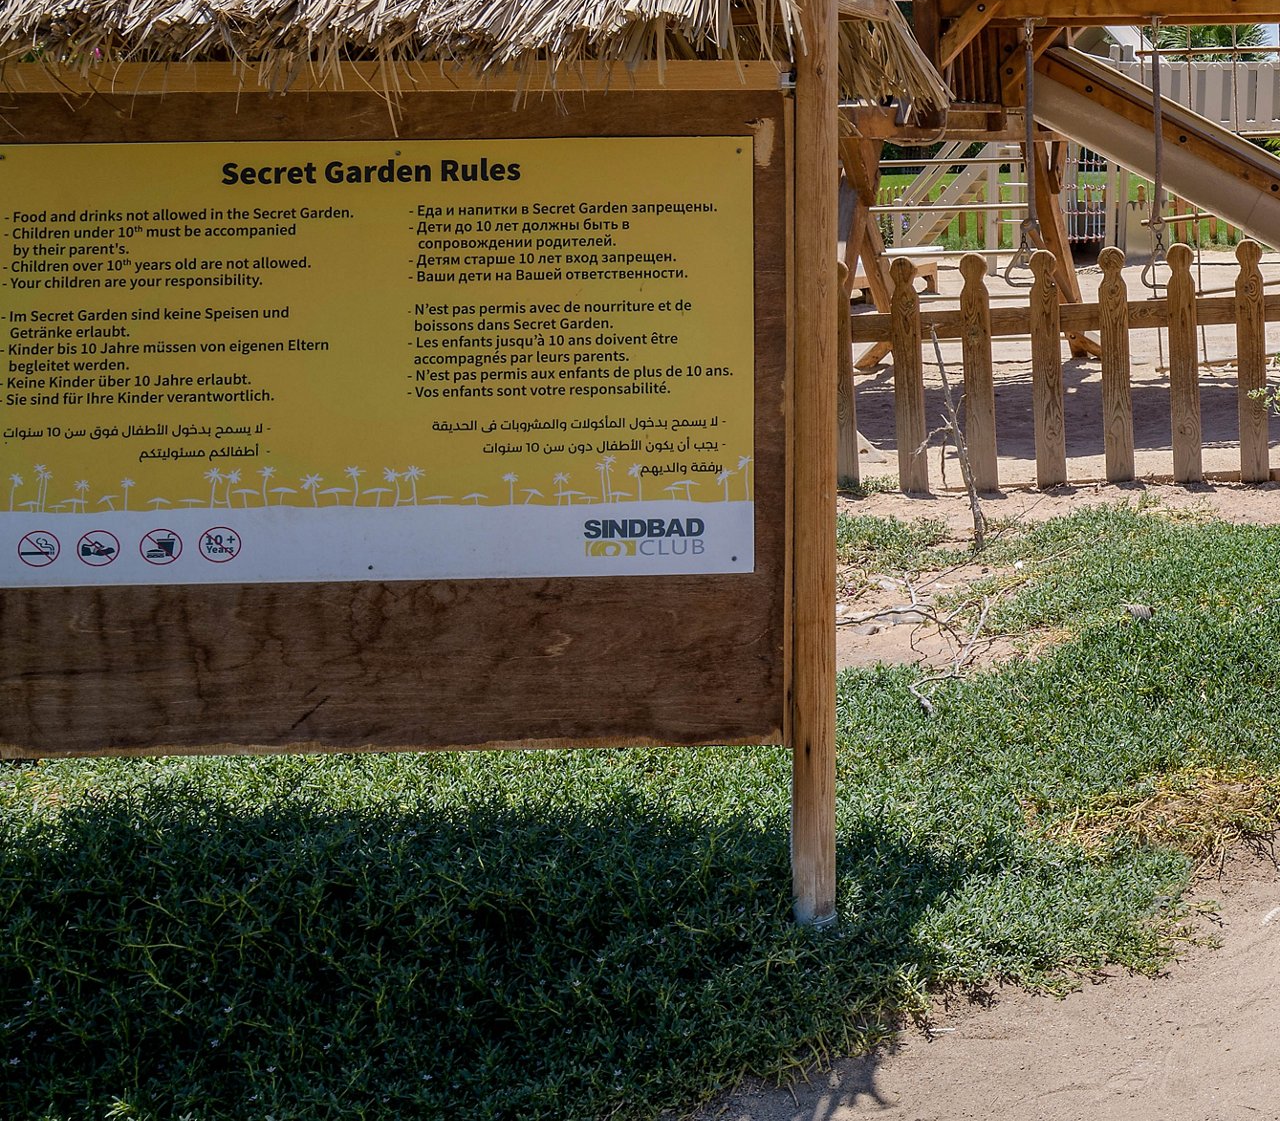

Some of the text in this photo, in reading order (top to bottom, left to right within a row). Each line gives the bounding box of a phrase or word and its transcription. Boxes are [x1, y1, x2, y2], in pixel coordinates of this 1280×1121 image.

[221, 157, 521, 185] Secret Garden Rules
[13, 206, 354, 223] Food and drinks not allowed in the Secret Garden.
[417, 205, 442, 219] Еда
[458, 206, 517, 216] напитки
[532, 203, 576, 215] Secret
[578, 201, 628, 214] Garden
[631, 203, 717, 216] запрещены.
[12, 226, 70, 240] Children
[73, 226, 115, 239] under
[146, 226, 181, 238] must
[184, 224, 201, 237] be
[204, 223, 296, 239] accompanied
[416, 221, 452, 236] Дети
[454, 223, 473, 235] до
[476, 220, 492, 232] 10
[494, 222, 519, 232] лет
[521, 221, 579, 234] должны
[583, 218, 619, 230] быть
[13, 244, 30, 259] by
[32, 243, 66, 256] their
[418, 234, 616, 252] сопровождении родителей.
[11, 259, 69, 273] Children
[72, 262, 104, 272] over
[134, 261, 172, 274] years
[175, 257, 197, 270] old
[200, 260, 223, 270] are
[226, 258, 250, 270] not
[252, 256, 311, 269] allowed.
[416, 253, 676, 269] Детям старше 10 лет вход запрещен.
[10, 273, 263, 290] Your children are your responsibility.
[417, 268, 688, 284] Ваши дети на Вашей ответственности.
[9, 306, 289, 322] Im Secret Garden sind keine Speisen und
[452, 305, 476, 318] pas
[479, 301, 526, 317] permis
[529, 304, 561, 314] avec
[564, 301, 581, 313] de
[584, 300, 655, 313] nourriture
[658, 300, 672, 311] et
[675, 299, 692, 312] de
[10, 325, 130, 339] Getränke erlaubt.
[414, 317, 613, 332] boissons dans Secret Garden.
[8, 338, 329, 356] Kinder bis 10 Jahre müssen von eigenen Eltern
[416, 337, 439, 348] Les
[441, 335, 493, 348] enfants
[549, 335, 565, 346] 10
[568, 336, 592, 346] ans
[595, 333, 647, 345] doivent
[651, 332, 678, 345] être
[8, 358, 130, 376] begleitet werden.
[414, 350, 629, 367] accompagnés par leurs parents.
[7, 373, 251, 389] Keine Kinder über 10 Jahre erlaubt.
[453, 371, 477, 384] pas
[480, 367, 527, 383] permis
[530, 370, 555, 379] aux
[558, 366, 610, 379] enfants
[613, 366, 630, 378] de
[634, 365, 662, 381] plus
[665, 365, 682, 377] de
[686, 365, 702, 377] 10
[705, 367, 733, 376] ans.
[6, 389, 274, 406] Sie sind für Ihre Kinder verantwortlich.
[415, 381, 671, 398] Vos enfants sont votre responsabilité.
[584, 518, 704, 538] SINDBAD
[639, 539, 705, 555] CLUB
